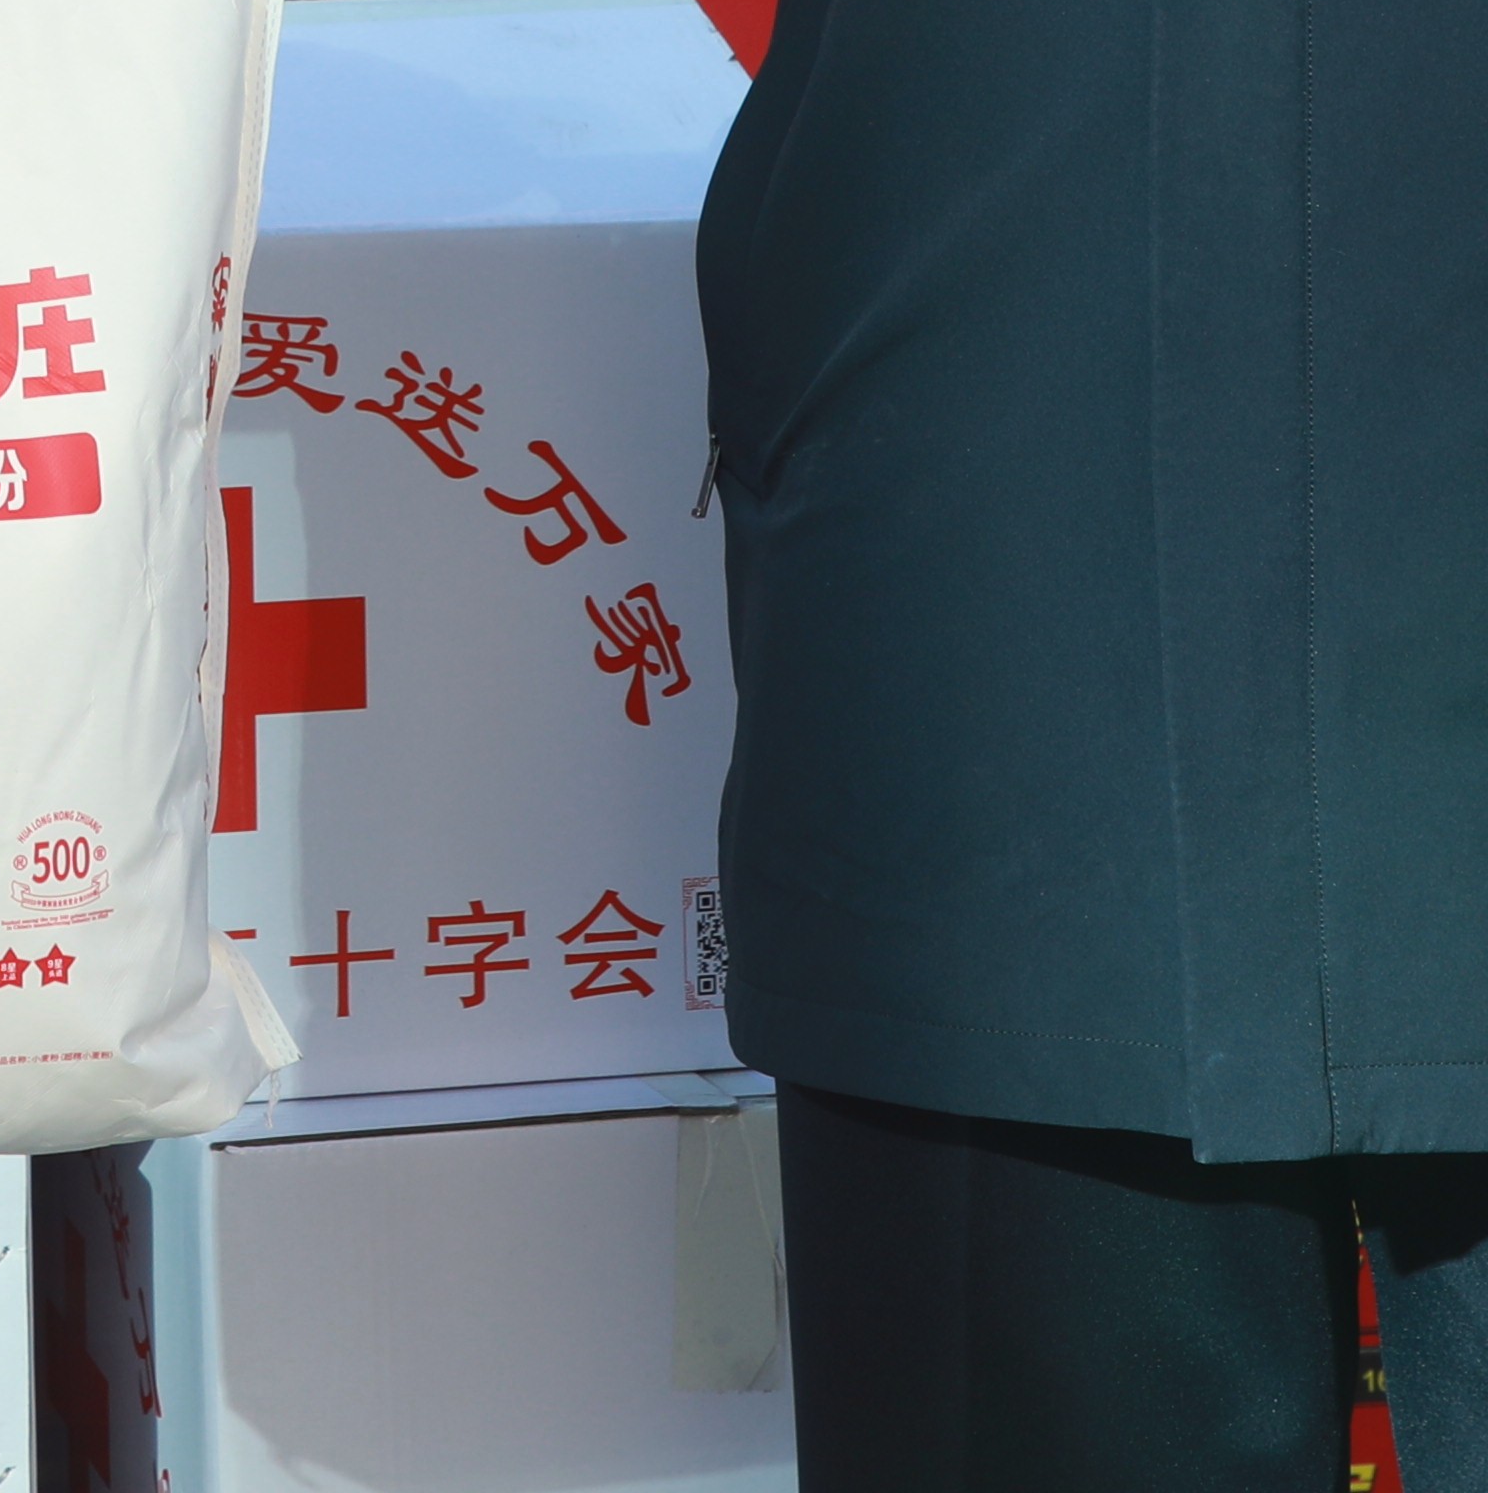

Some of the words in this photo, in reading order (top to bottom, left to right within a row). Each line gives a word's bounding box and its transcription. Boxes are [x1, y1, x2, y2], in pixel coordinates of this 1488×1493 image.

[31, 813, 53, 831] LONG
[32, 836, 90, 884] 500
[224, 888, 667, 1019] 十字会
[0, 962, 17, 973] 8星
[47, 958, 63, 969] 9星
